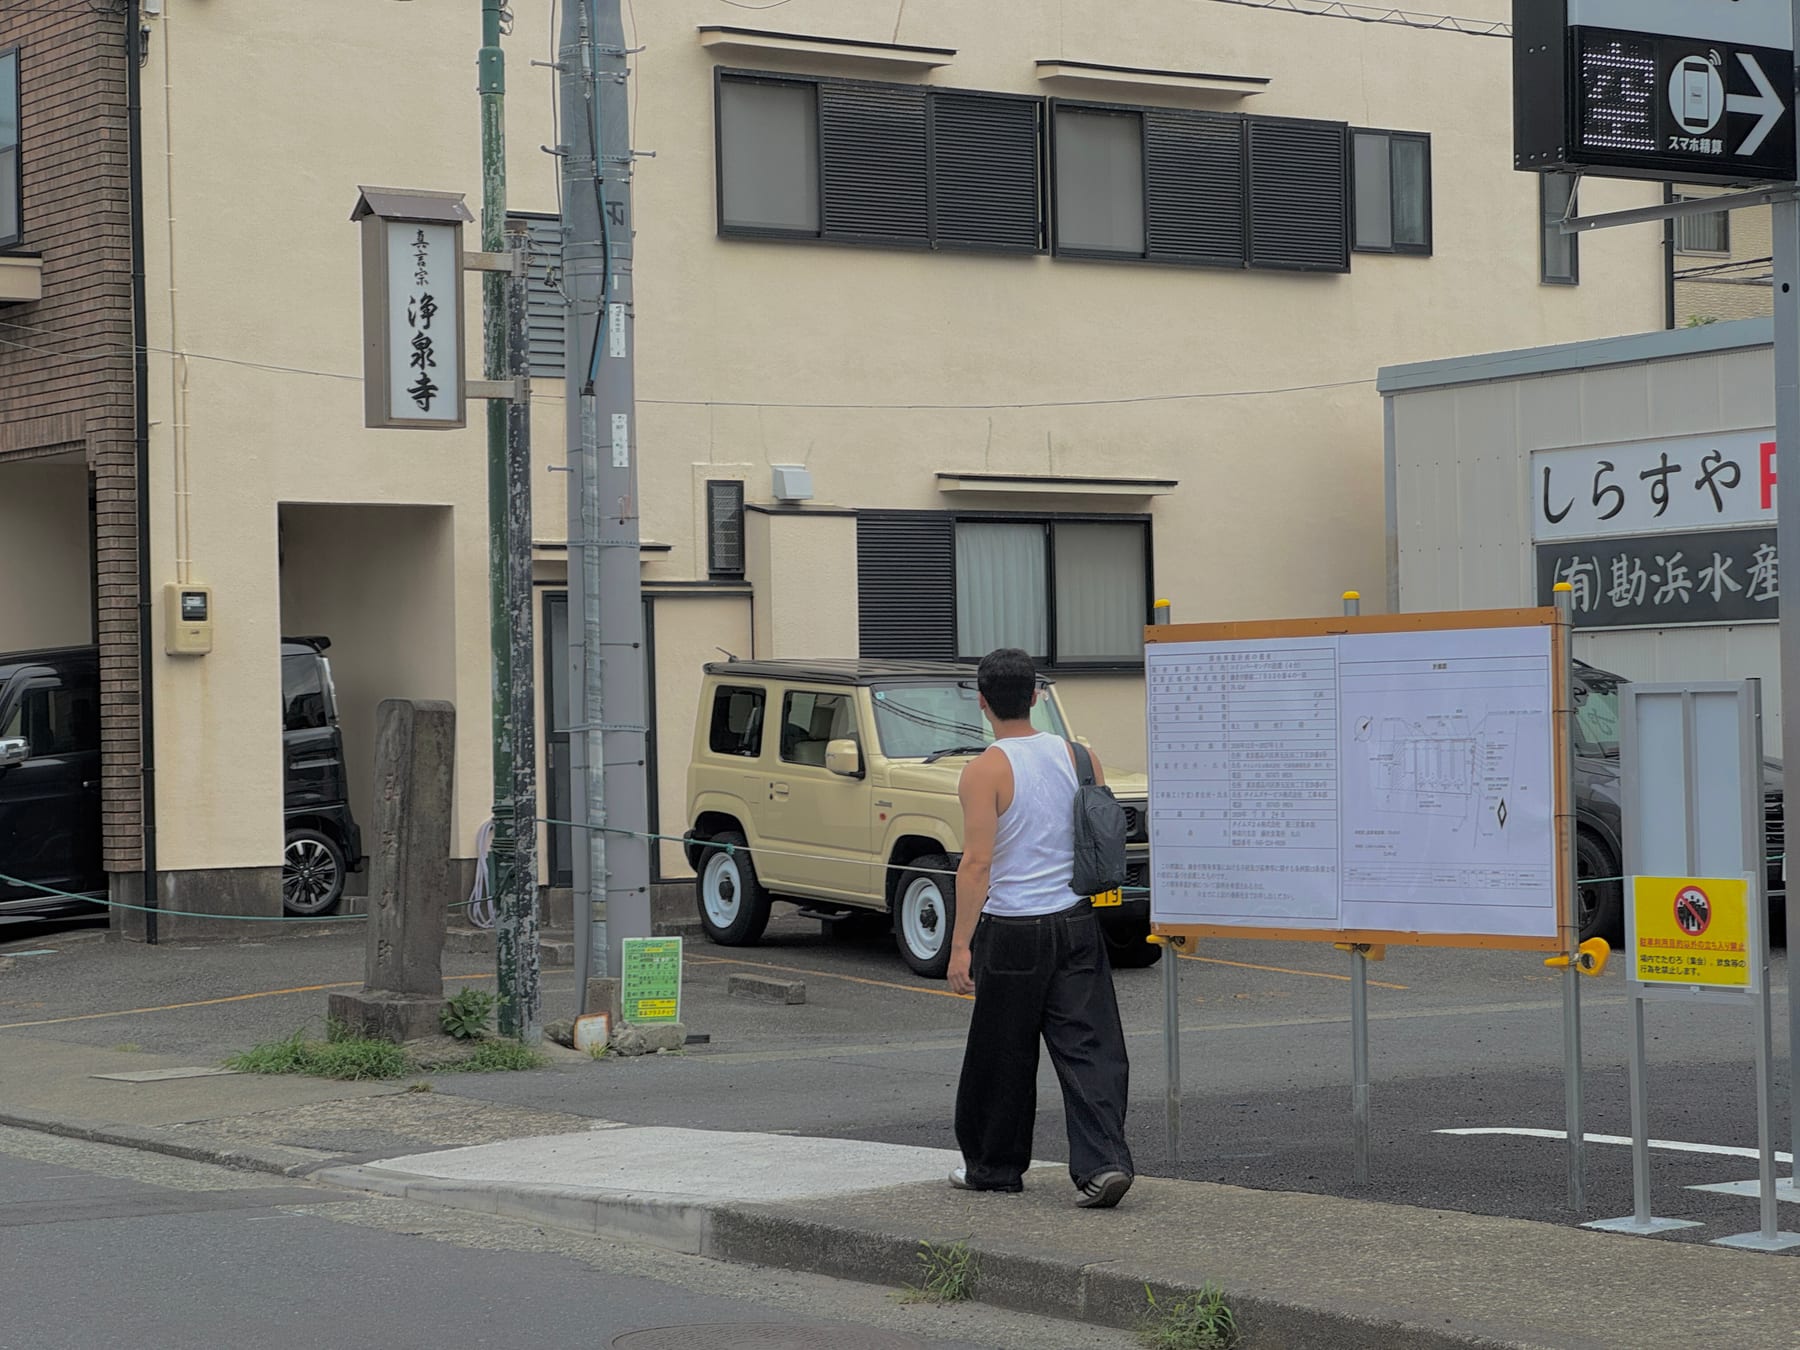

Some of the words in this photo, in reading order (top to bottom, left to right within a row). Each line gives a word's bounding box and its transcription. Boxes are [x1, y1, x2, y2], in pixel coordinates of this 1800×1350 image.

[1668, 135, 1724, 156] スマホ精算
[411, 228, 430, 287] 真言宗
[407, 291, 440, 412] 浄泉寺
[1543, 449, 1741, 524] しらすや
